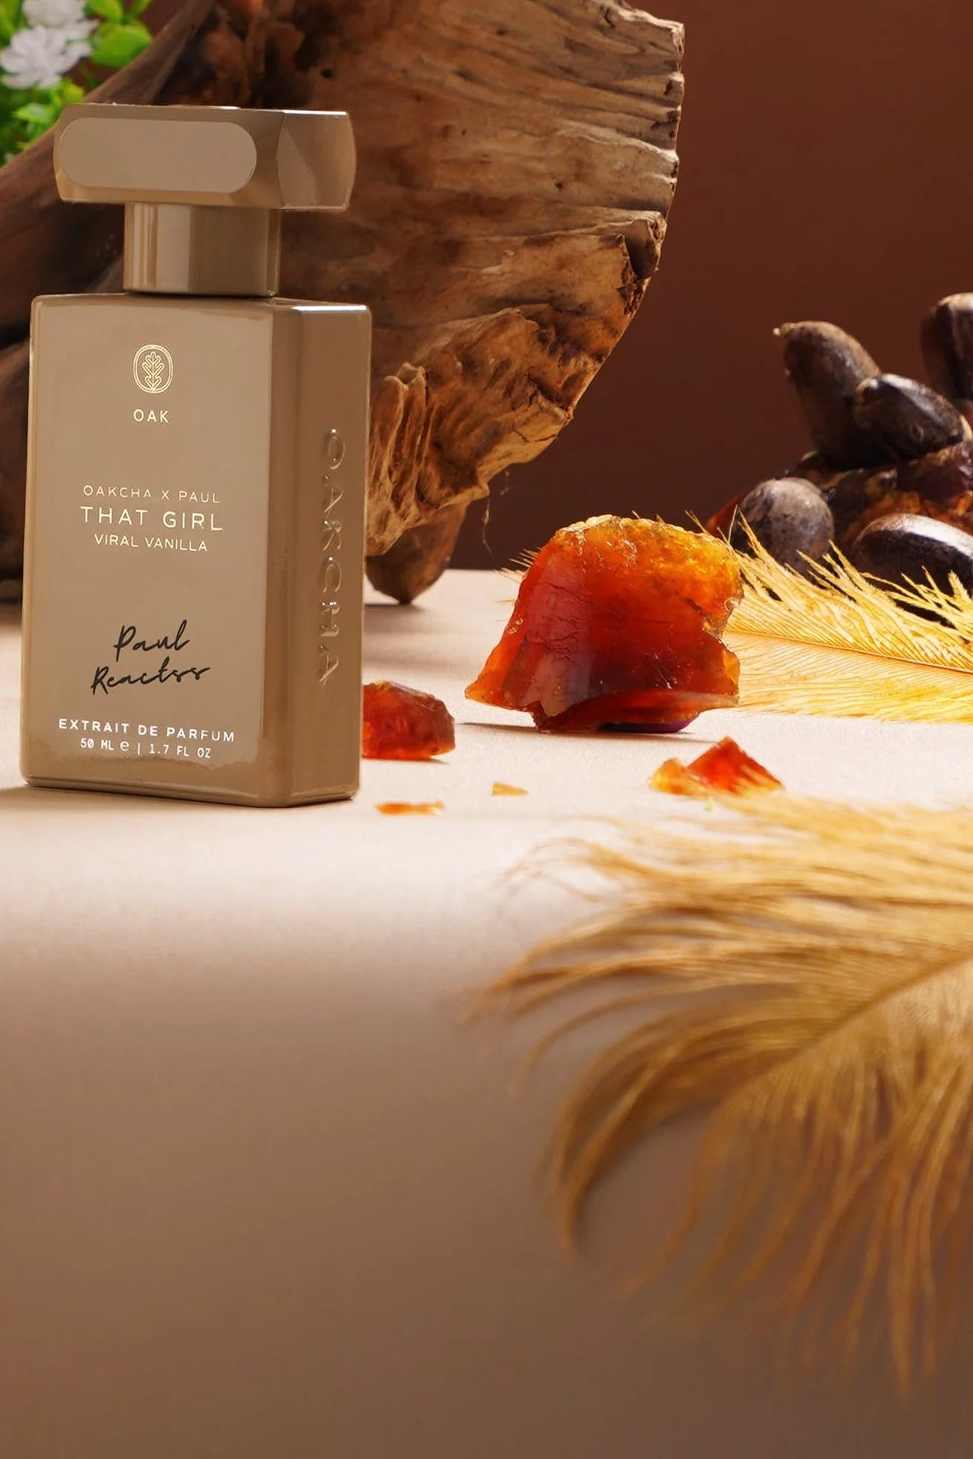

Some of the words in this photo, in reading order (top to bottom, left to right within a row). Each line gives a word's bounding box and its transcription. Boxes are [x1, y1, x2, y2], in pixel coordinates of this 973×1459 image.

[133, 408, 169, 423] OAK
[83, 485, 152, 498] OAKCHA
[178, 490, 220, 504] PAUL
[80, 506, 148, 525] THAT
[162, 511, 223, 531] GIRL
[94, 533, 139, 547] VIRAL
[145, 537, 208, 552] VANILLA
[319, 428, 346, 686] OAKCHA
[113, 619, 190, 662] Paul
[58, 718, 129, 734] EXTRAIT
[138, 725, 158, 736] DE
[167, 727, 235, 742] PARFUM
[80, 738, 94, 749] 50
[101, 740, 114, 751] ML
[150, 744, 169, 755] 1.7
[177, 745, 190, 757] FL
[197, 747, 211, 759] OZ
